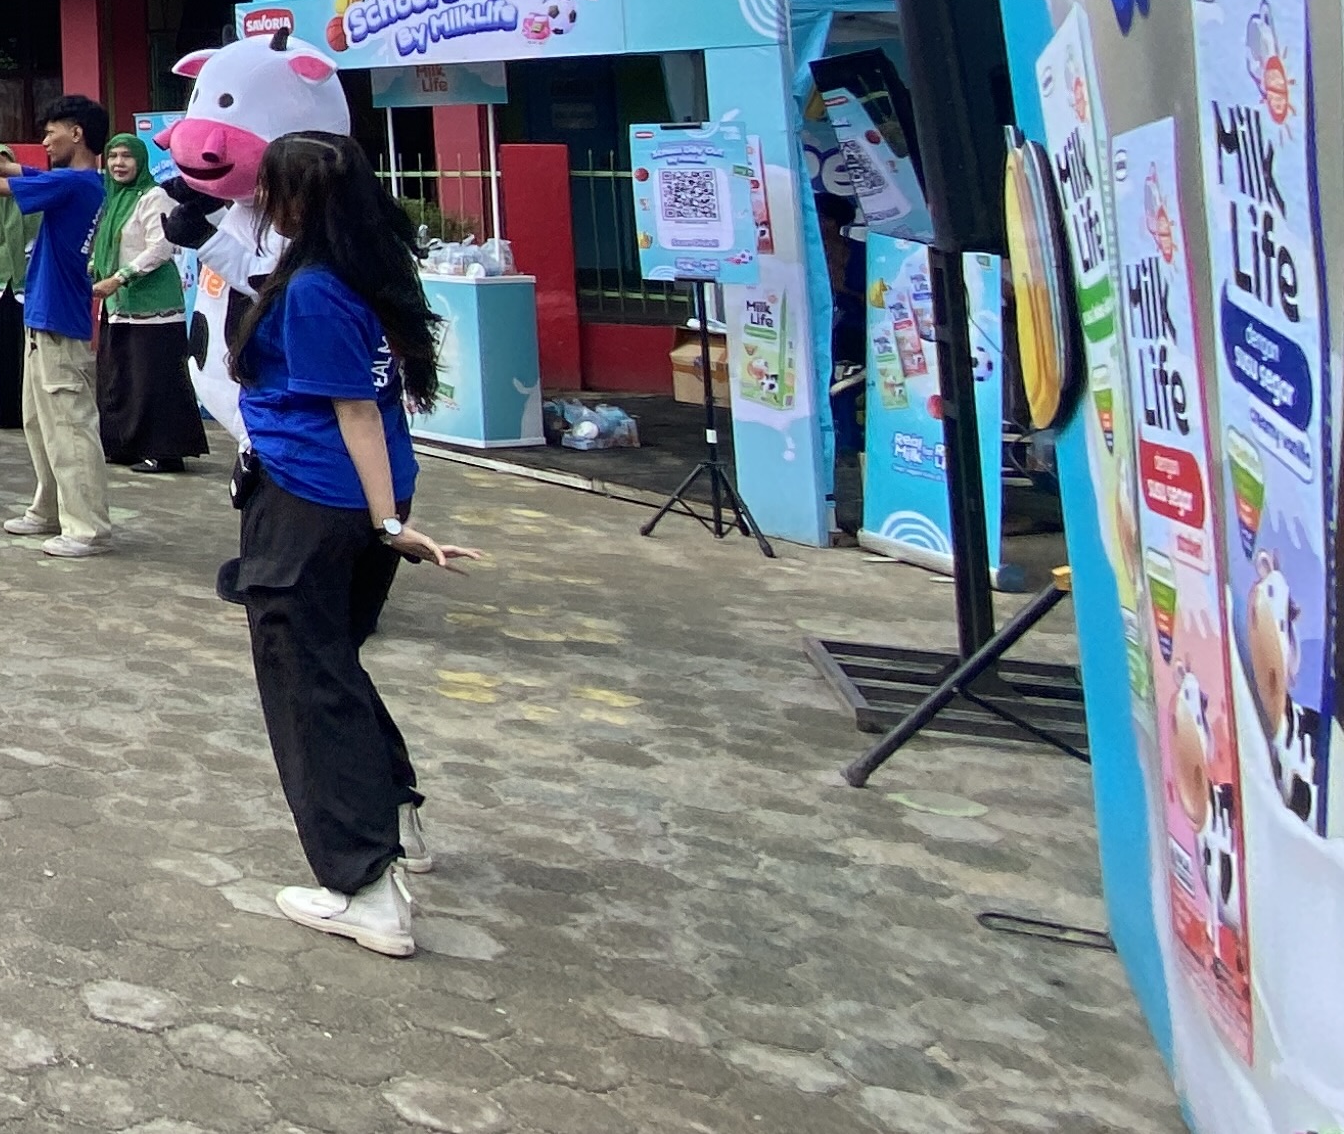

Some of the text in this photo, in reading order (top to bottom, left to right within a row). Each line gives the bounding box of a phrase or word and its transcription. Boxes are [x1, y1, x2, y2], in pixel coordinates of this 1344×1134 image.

[246, 15, 291, 34] SAVORIA
[395, 27, 429, 57] By
[422, 78, 449, 92] Life
[1055, 127, 1094, 210] Milk
[1211, 100, 1288, 219] Milk
[80, 228, 95, 255] REAL
[1073, 196, 1105, 274] Life
[1229, 200, 1302, 323] Life
[746, 300, 773, 315] Milk
[1126, 256, 1178, 345] Milk
[751, 312, 774, 328] Life
[370, 356, 393, 392] EAL
[1139, 344, 1190, 436] Life
[894, 432, 923, 449] Real
[894, 445, 924, 464] Milk
